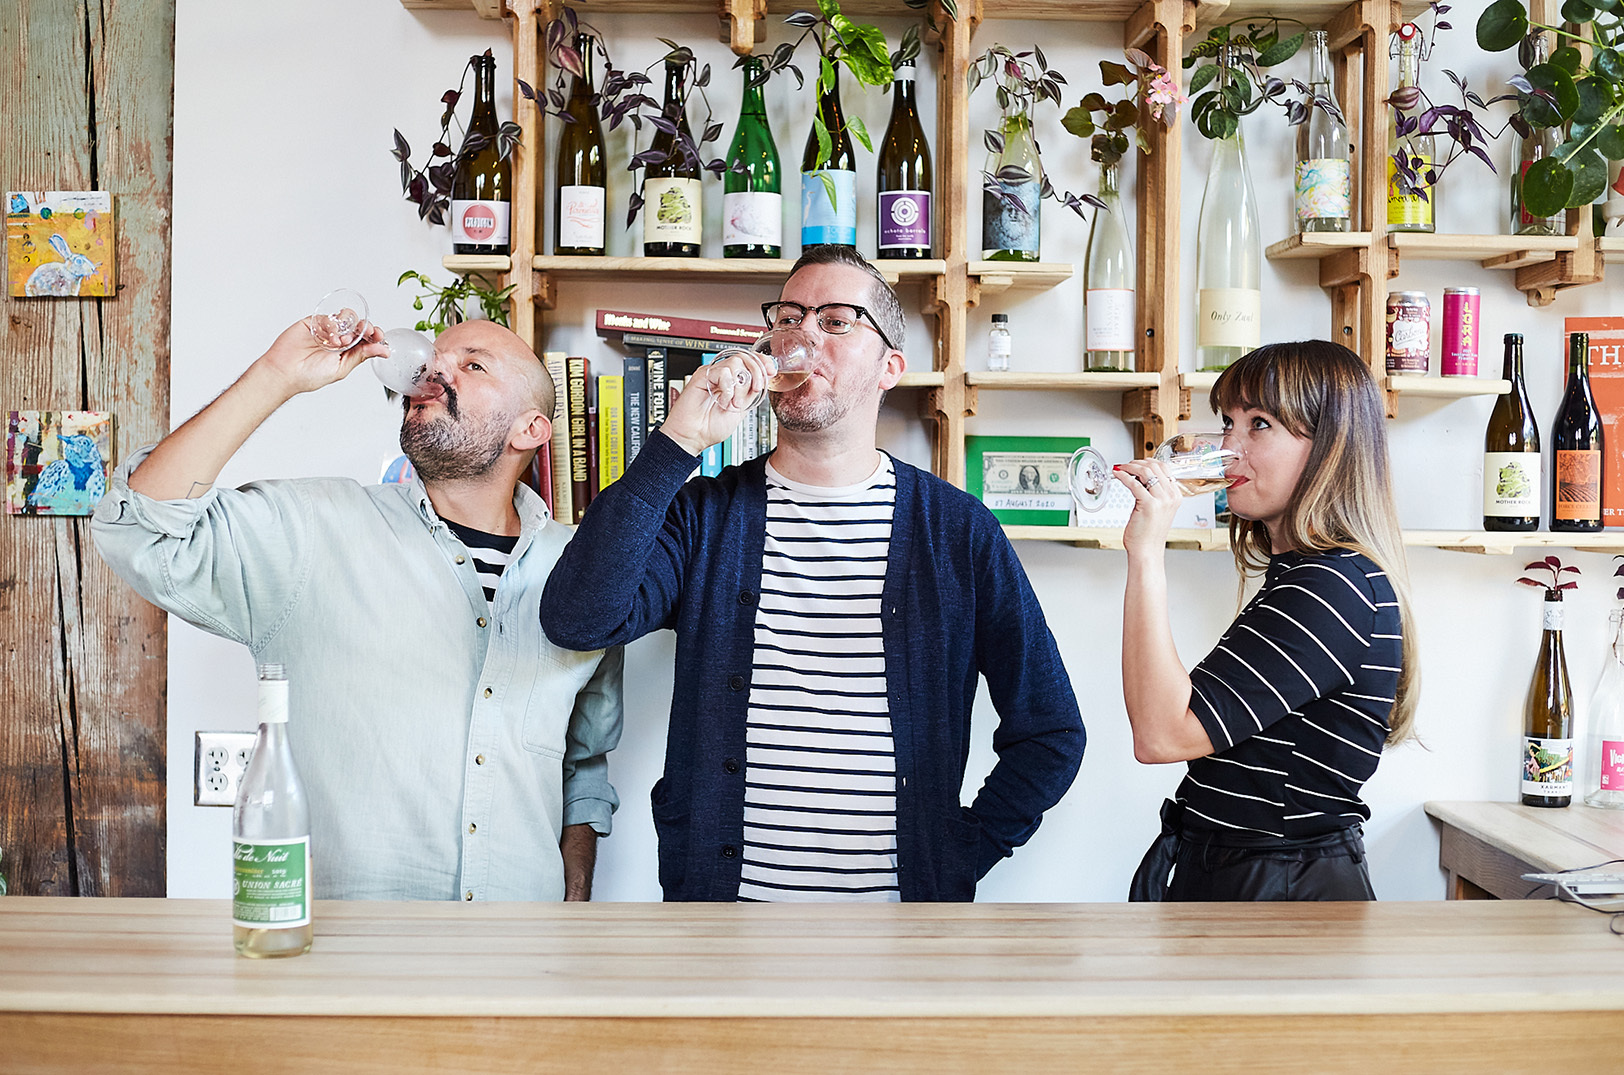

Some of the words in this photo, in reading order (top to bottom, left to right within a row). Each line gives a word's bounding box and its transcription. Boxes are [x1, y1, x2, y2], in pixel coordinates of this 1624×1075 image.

[604, 313, 632, 327] Monks
[633, 318, 649, 329] and
[649, 317, 671, 331] Wine
[1210, 310, 1231, 325] Only
[685, 340, 709, 349] WINE
[1588, 345, 1624, 365] TH
[569, 359, 584, 377] KIM
[653, 361, 664, 390] WINE
[570, 379, 585, 415] GORDON
[630, 392, 639, 406] THE
[653, 392, 665, 423] FOLLY
[631, 408, 640, 425] NEW
[571, 418, 586, 437] GIRL
[610, 420, 618, 435] BAND
[572, 438, 586, 450] IN
[630, 426, 640, 462] CALIFOR
[573, 457, 587, 482] BAND
[1006, 499, 1033, 507] AUGUST
[1617, 508, 1624, 516] T
[254, 849, 290, 863] Nuit
[242, 880, 271, 889] UNION
